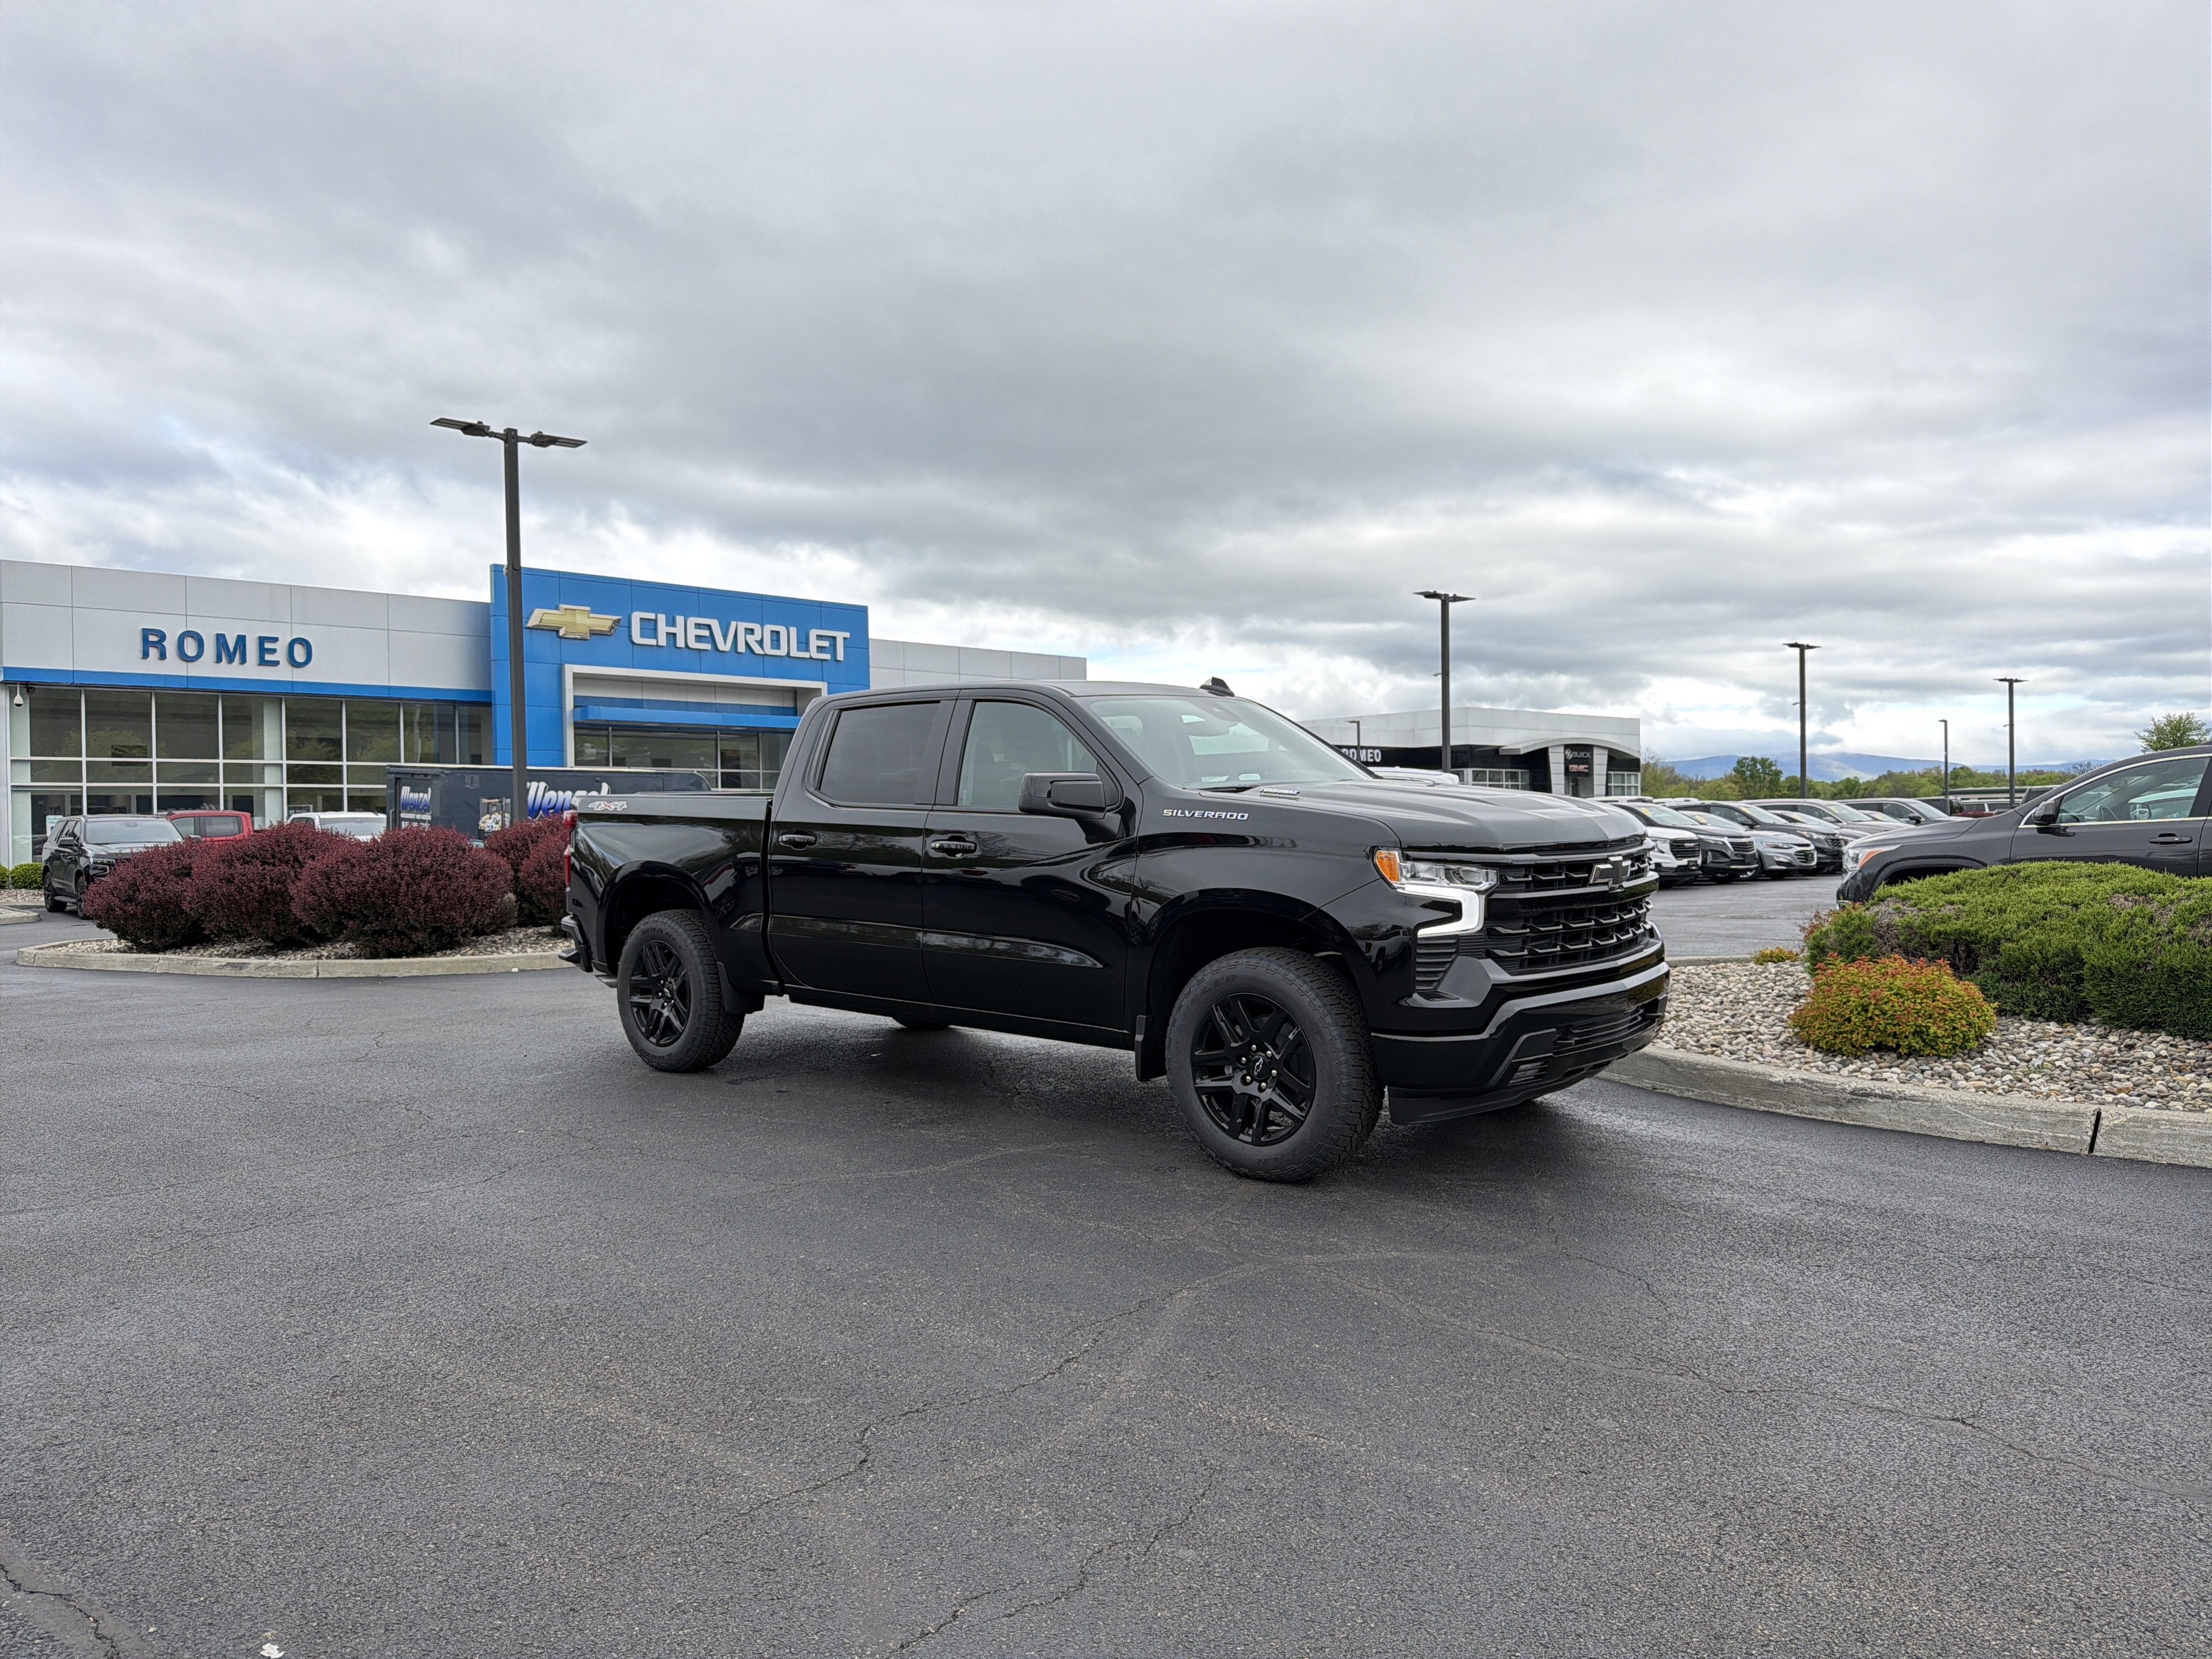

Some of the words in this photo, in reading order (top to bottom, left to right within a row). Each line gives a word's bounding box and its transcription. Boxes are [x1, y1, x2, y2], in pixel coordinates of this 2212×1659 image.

[141, 628, 313, 668] ROMEO
[630, 611, 850, 662] CHEVROLET
[1569, 764, 1589, 772] GMC
[400, 786, 432, 814] Wenzel
[1163, 809, 1249, 821] SILVERADO
